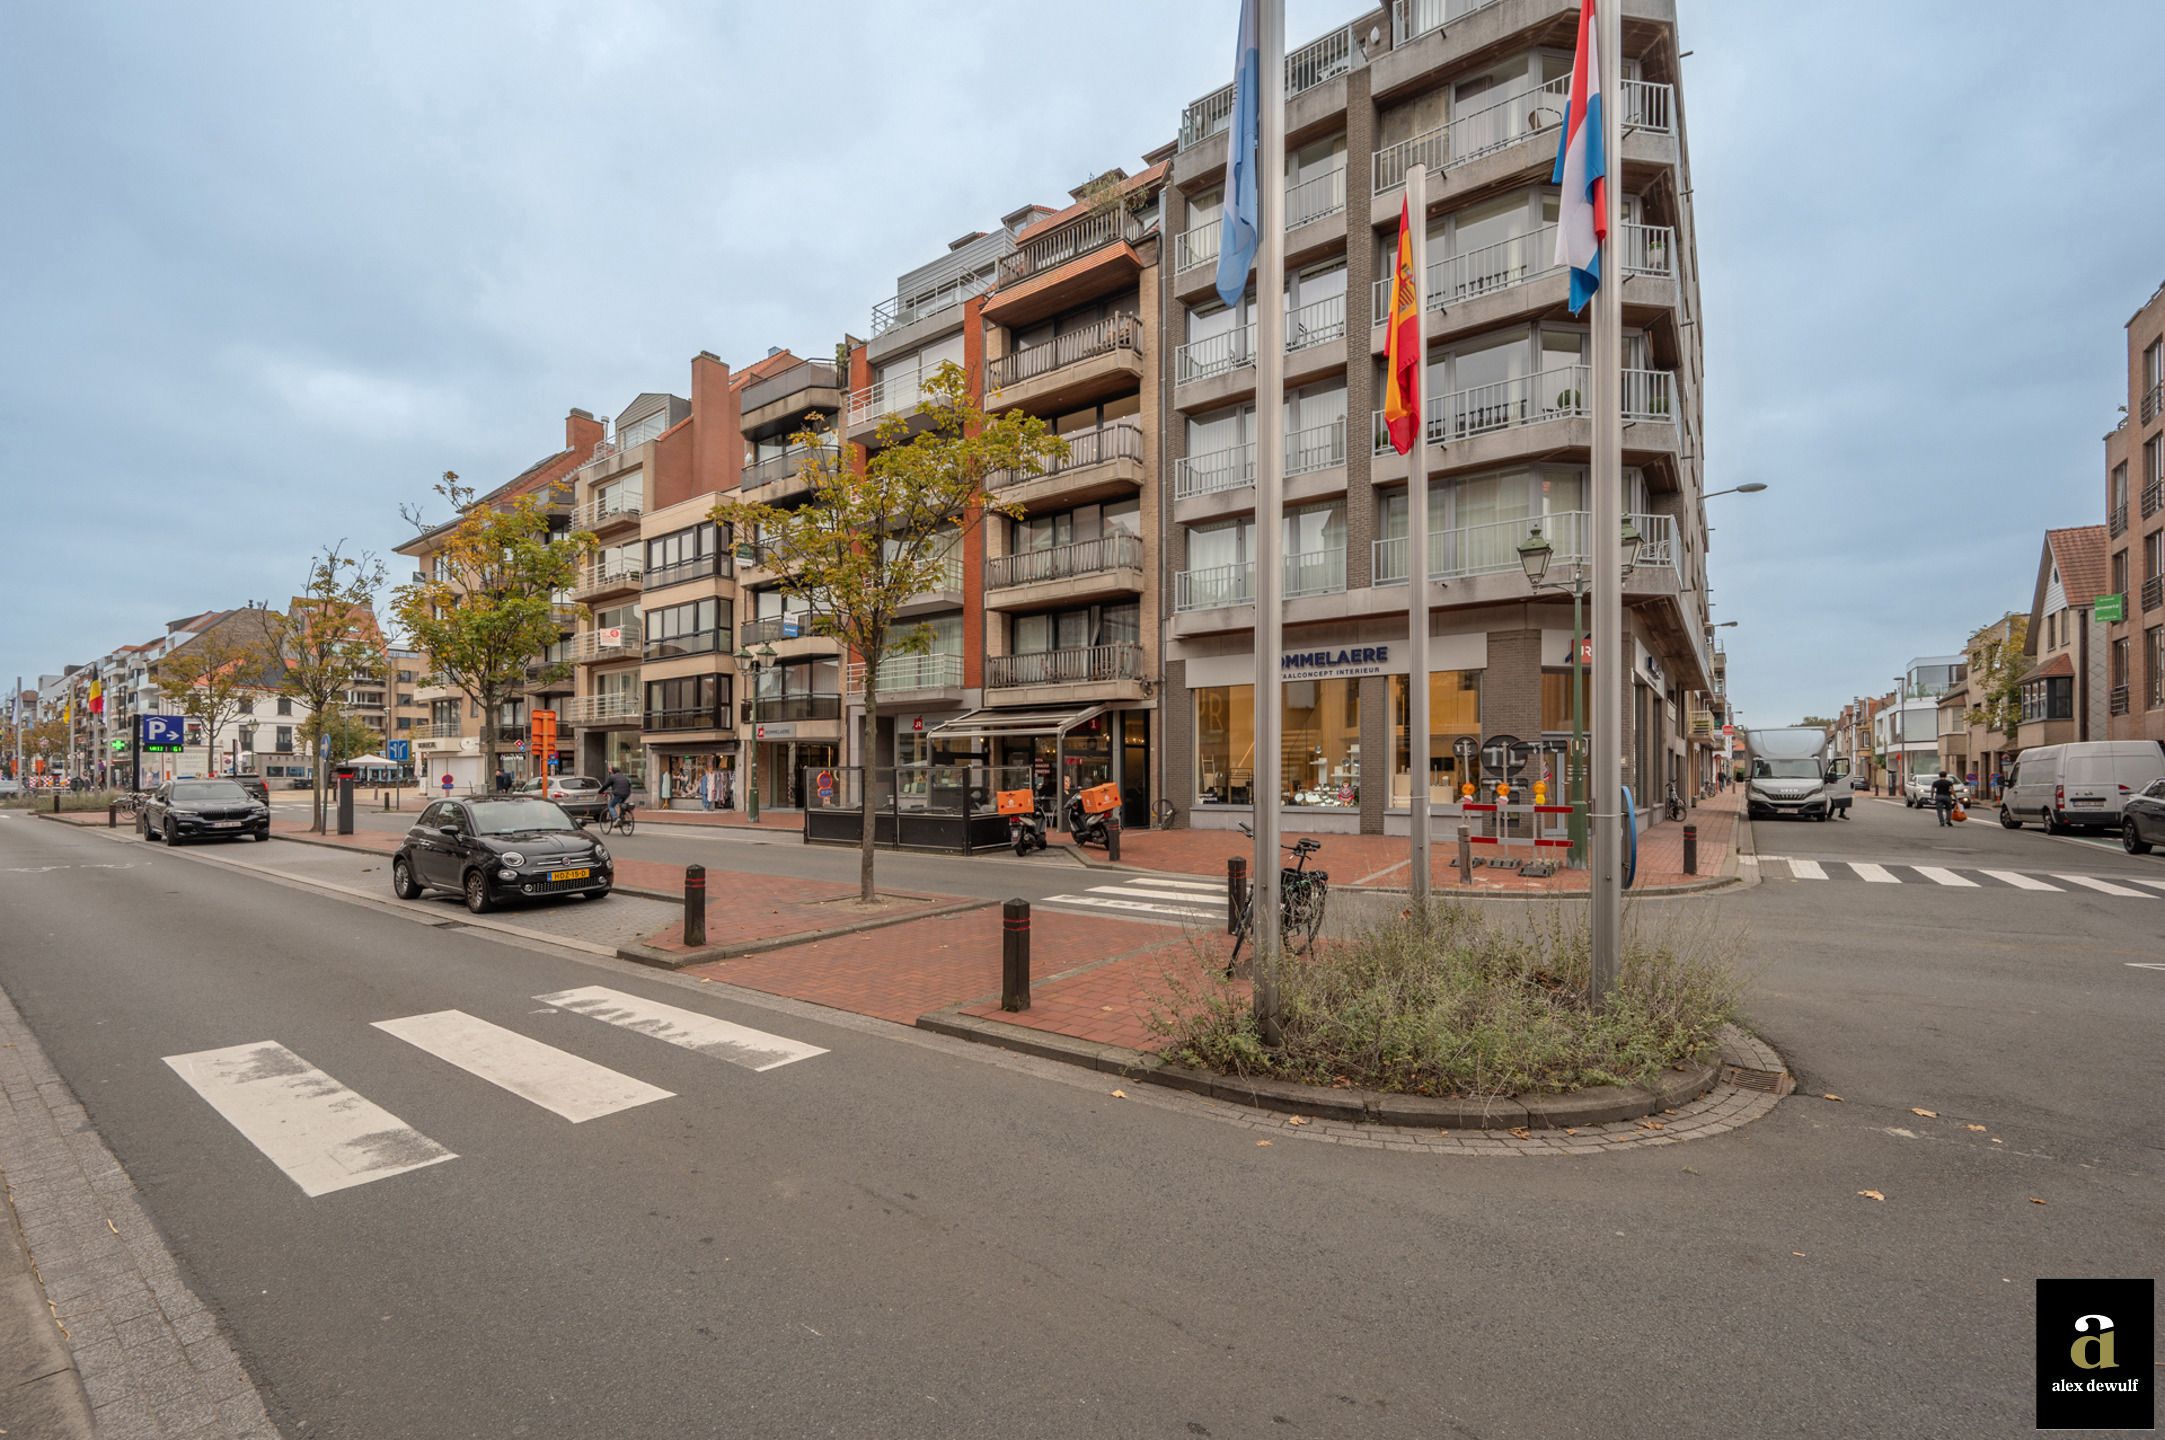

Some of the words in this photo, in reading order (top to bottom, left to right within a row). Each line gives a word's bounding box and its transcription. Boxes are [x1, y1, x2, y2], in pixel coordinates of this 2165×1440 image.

[1281, 670, 1333, 679] AALCONCEPT
[1337, 667, 1380, 676] INTERIEUR
[149, 721, 166, 740] P
